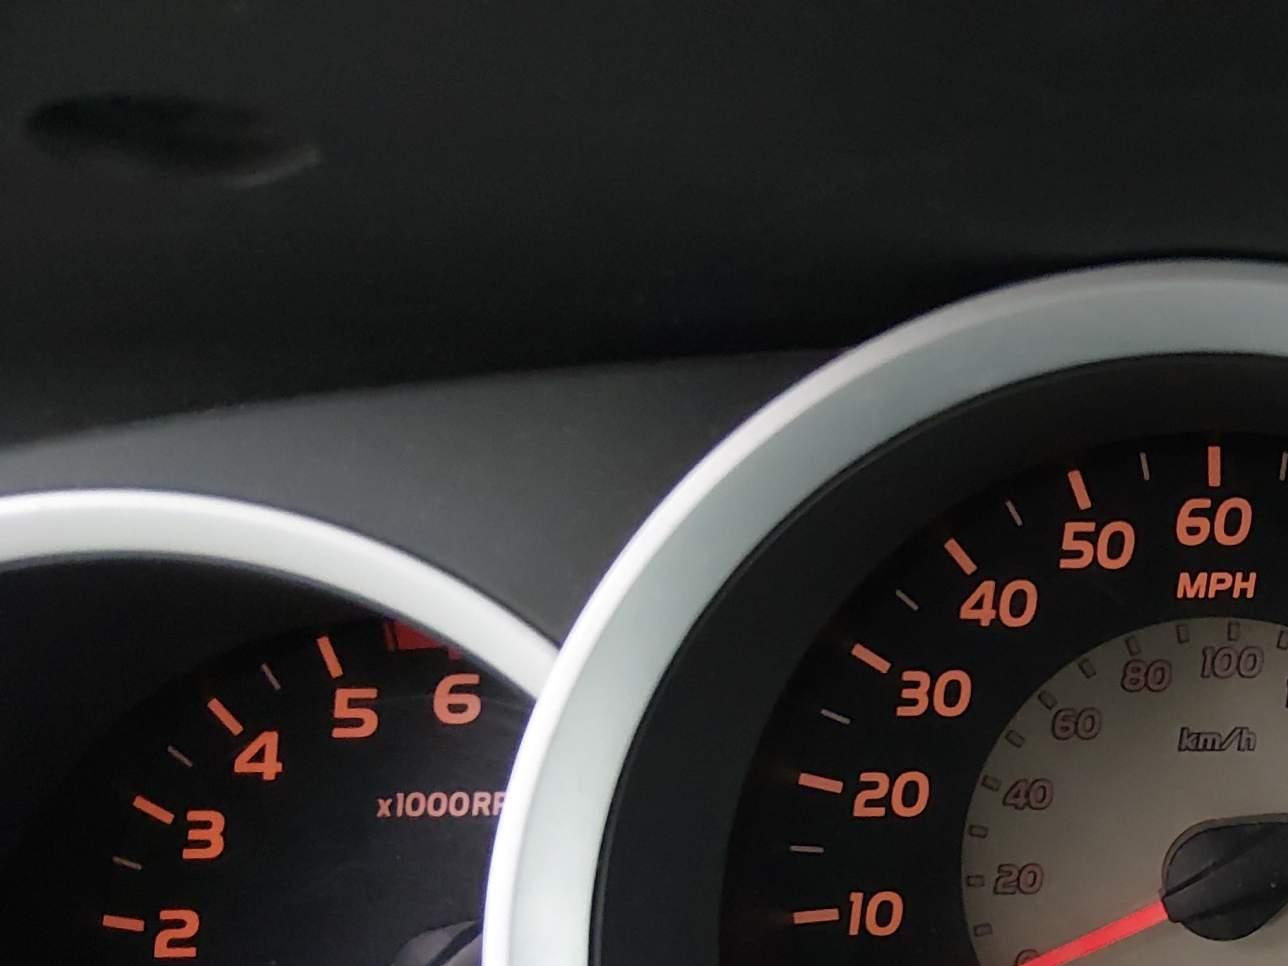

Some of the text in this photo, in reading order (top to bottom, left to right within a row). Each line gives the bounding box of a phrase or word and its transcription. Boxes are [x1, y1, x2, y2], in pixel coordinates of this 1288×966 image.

[1176, 498, 1252, 546] 60
[1059, 522, 1135, 569] 50
[960, 580, 1038, 627] 40
[1176, 572, 1256, 599] MPH
[1121, 659, 1172, 692] 80
[1201, 646, 1264, 679] 100
[331, 687, 379, 738] 5
[433, 673, 481, 724] 6
[897, 670, 972, 717] 30
[1052, 707, 1100, 740] 60
[1178, 727, 1256, 753] km/h
[234, 731, 282, 780] 4
[853, 772, 929, 817] 20
[1003, 778, 1053, 810] 40
[182, 811, 225, 859] 3
[993, 863, 1044, 894] 20
[154, 909, 200, 958] 2
[848, 892, 903, 936] 10
